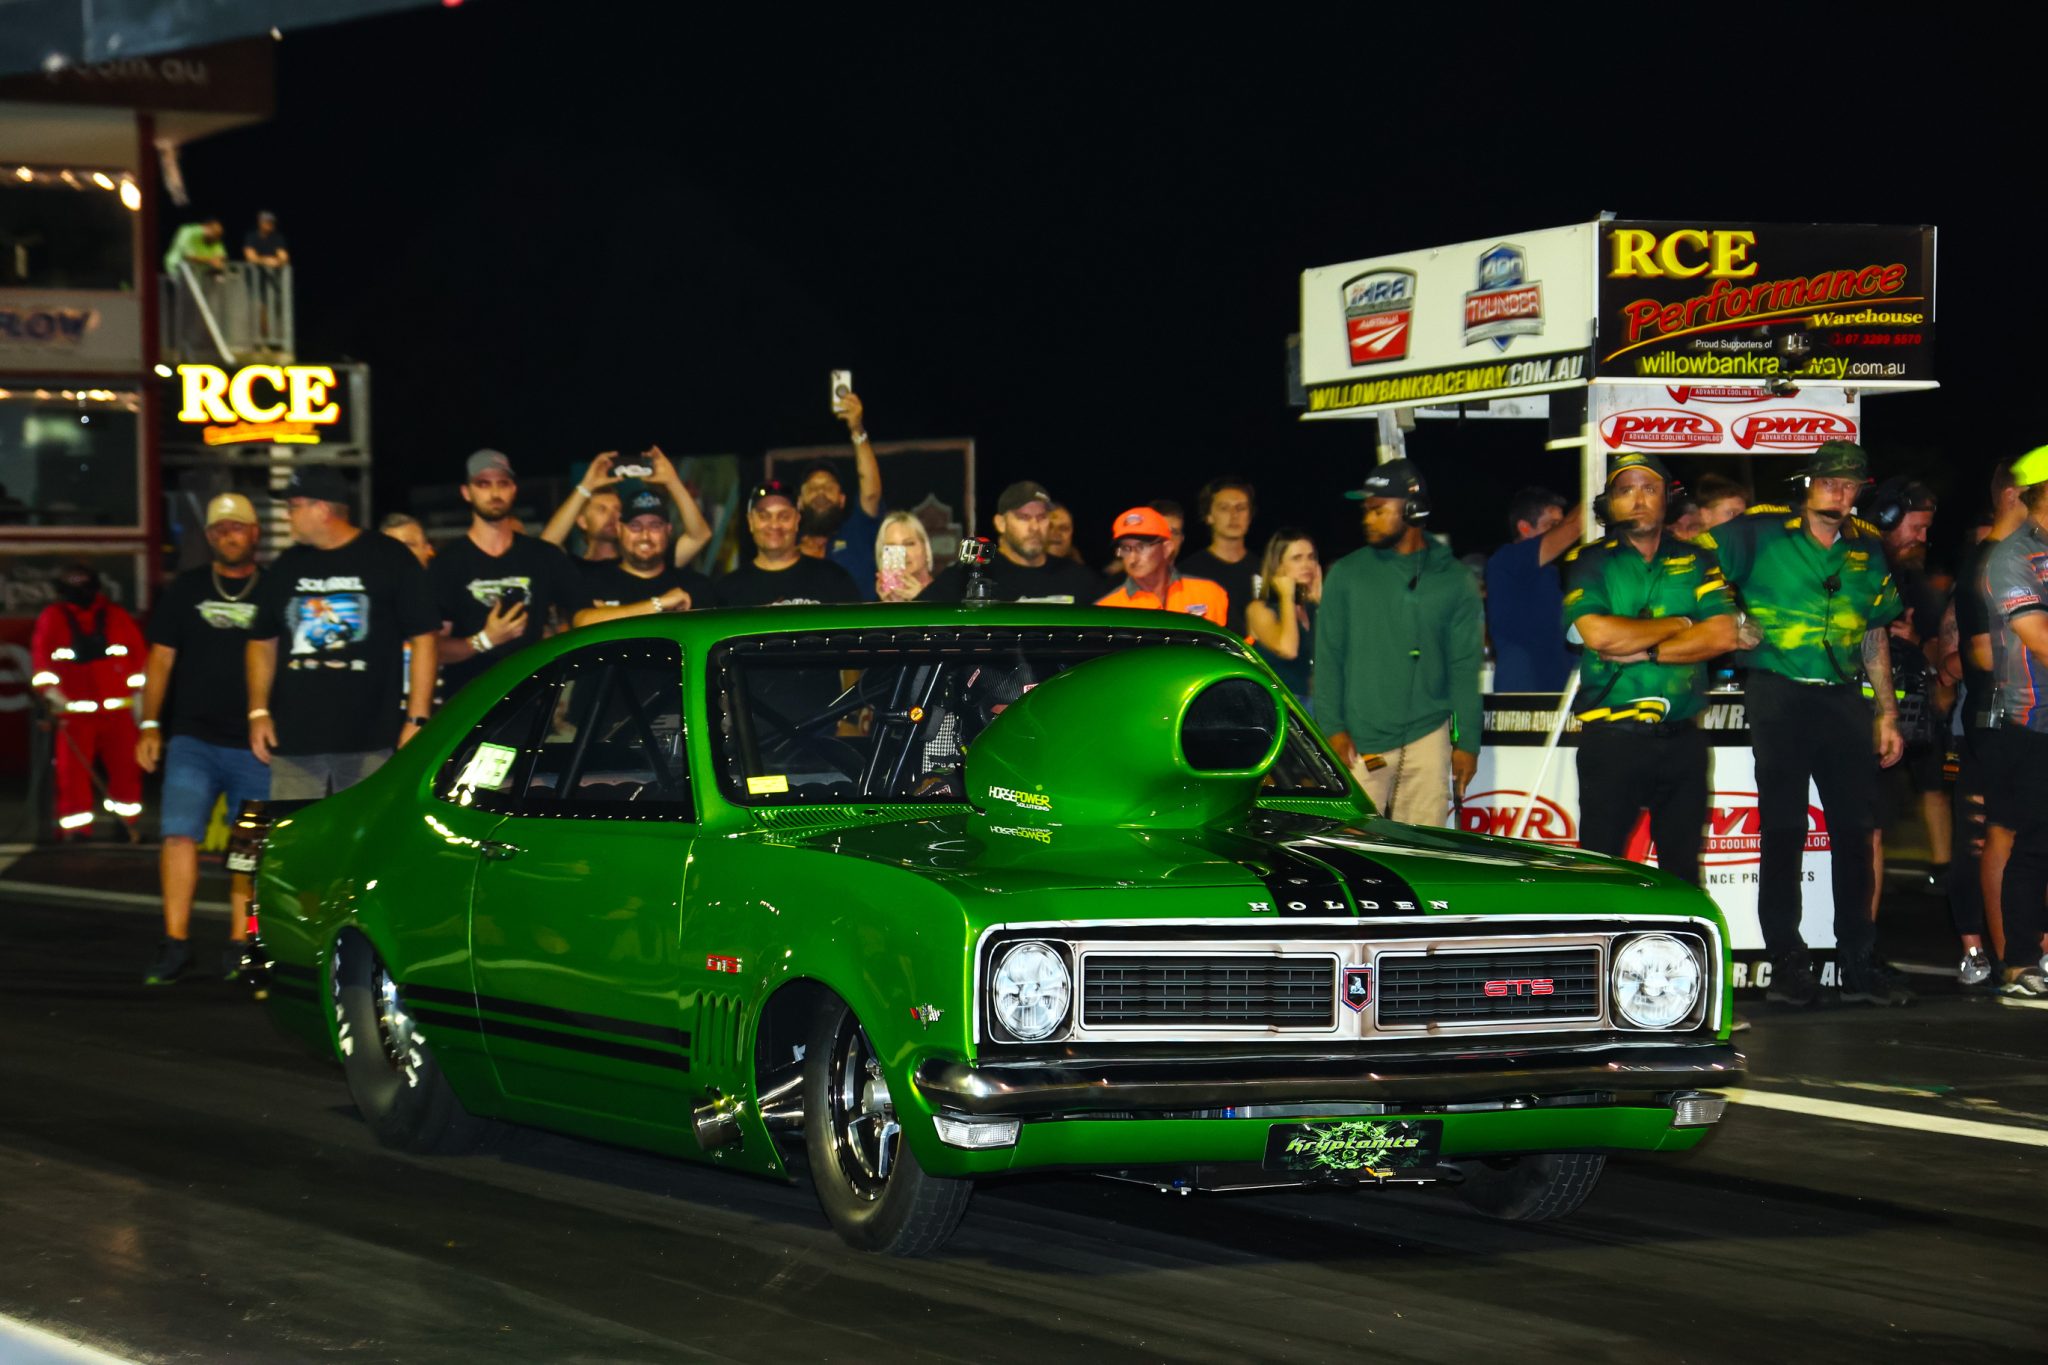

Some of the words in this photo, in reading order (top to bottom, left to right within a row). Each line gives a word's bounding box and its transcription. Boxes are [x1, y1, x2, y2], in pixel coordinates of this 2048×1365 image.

[1612, 229, 1758, 278] RCE
[1469, 291, 1540, 321] THUNDER
[1626, 263, 1907, 341] Performance
[1813, 309, 1923, 327] Warehouse
[1695, 339, 1719, 349] Proud
[1721, 339, 1763, 351] Supporters
[1764, 339, 1773, 349] of
[1643, 352, 1906, 380] willowbankraway.com.au
[178, 365, 340, 424] RCE
[1309, 355, 1584, 411] WILLOWBANKRACEWAY.COM.AU
[1695, 387, 1726, 396] ADVANCED
[1727, 388, 1752, 396] COOLING
[1606, 416, 1703, 449] PWR
[1629, 433, 1660, 441] ADVANCED
[1661, 433, 1686, 441] COOLING
[1738, 417, 1836, 449] PWR
[1761, 433, 1792, 441] ADVANCED
[1793, 433, 1818, 441] COOLING
[1248, 899, 1449, 912] HOLDEN
[1484, 979, 1554, 997] GTS
[1285, 1133, 1420, 1155] Kryptonite
